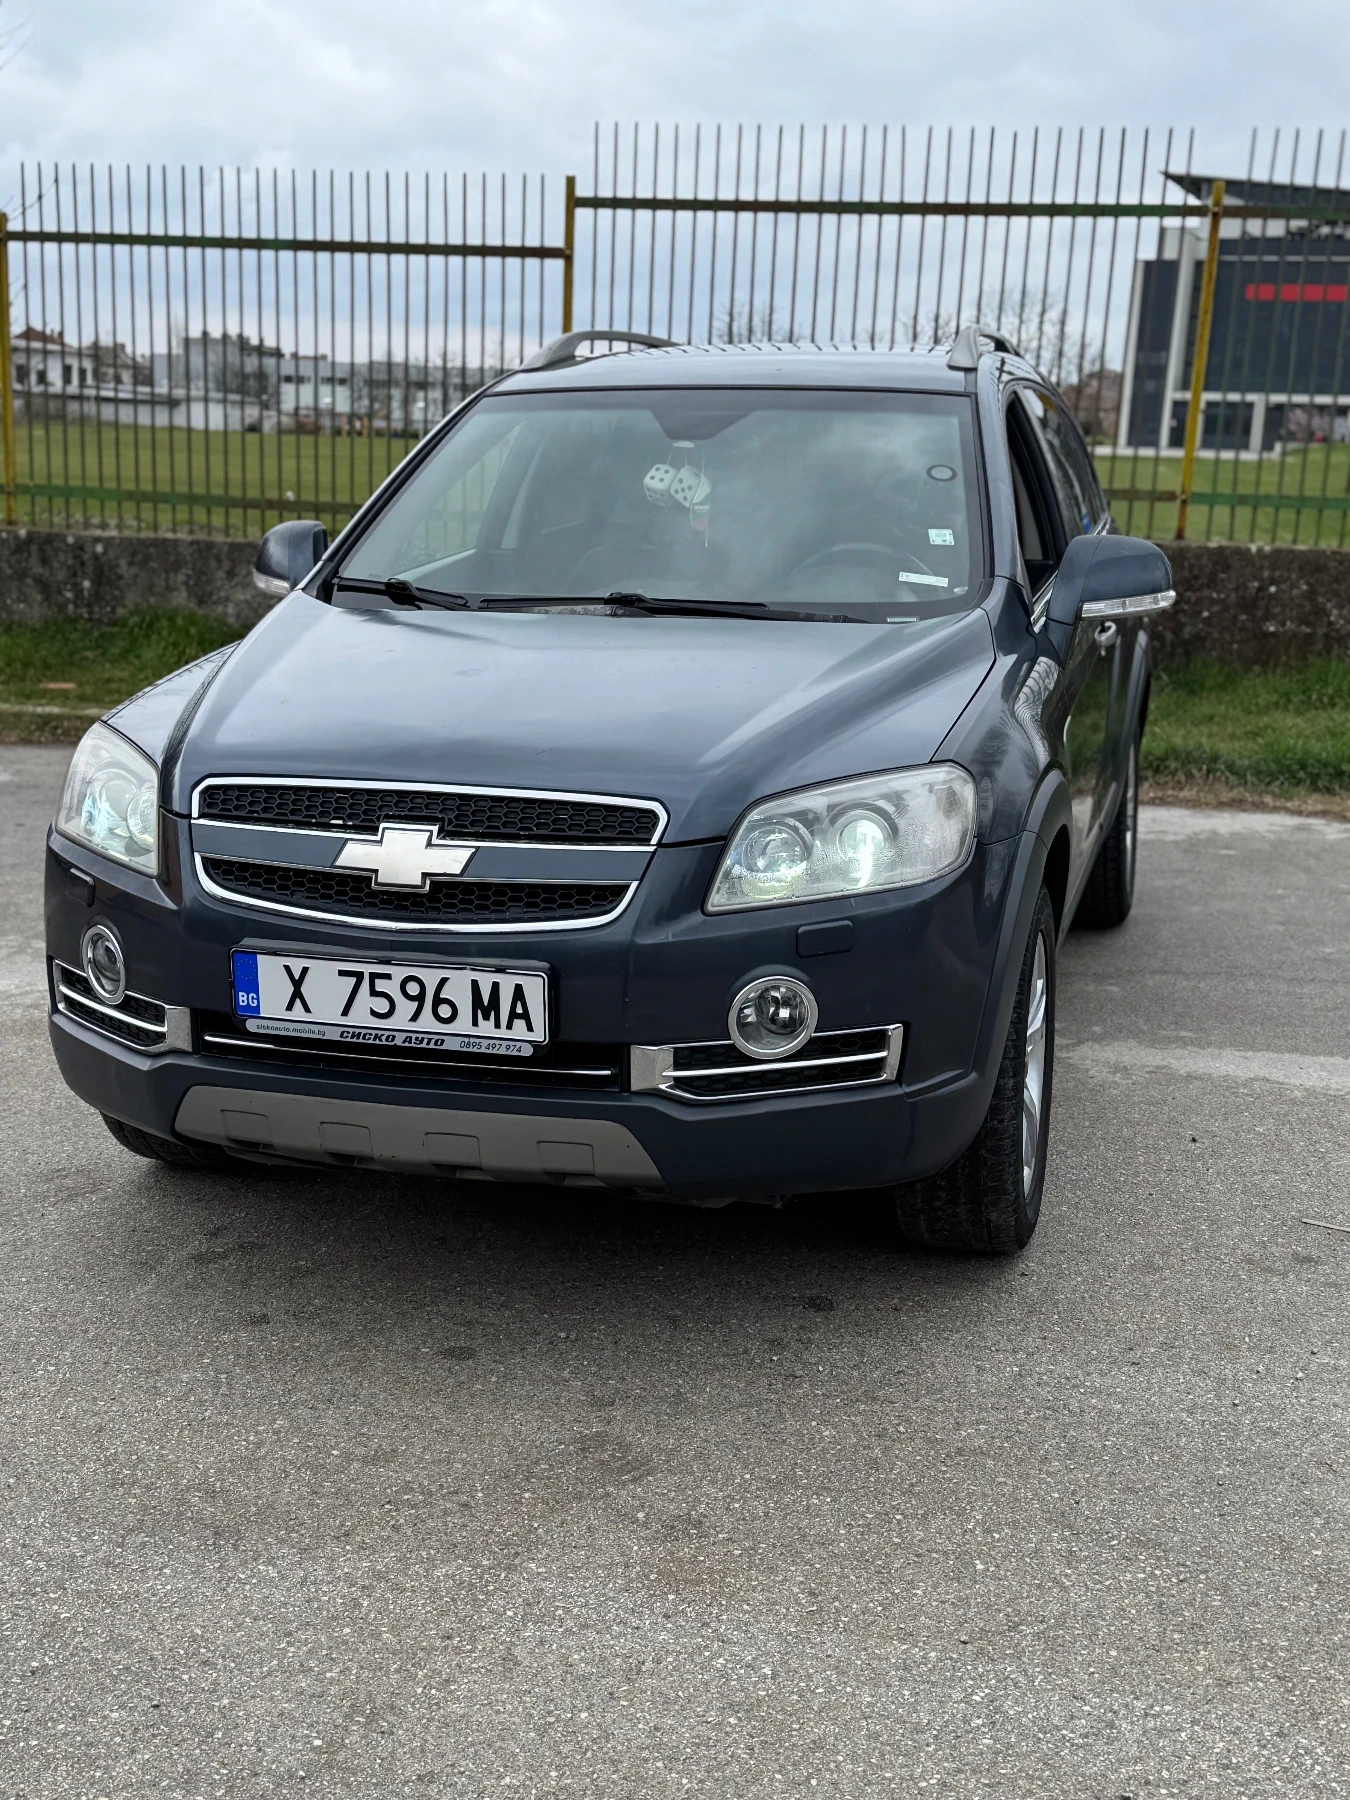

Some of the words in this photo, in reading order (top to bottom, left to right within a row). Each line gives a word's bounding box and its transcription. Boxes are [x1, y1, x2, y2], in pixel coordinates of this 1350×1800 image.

[238, 991, 258, 1007] BG
[282, 963, 313, 1014] X
[337, 969, 459, 1025] 7596
[470, 978, 535, 1033] MA
[256, 1023, 326, 1038] siskoauto.mobile.bg
[339, 1030, 397, 1044] СИСКО
[401, 1034, 446, 1048] АУТО
[459, 1039, 483, 1051] 0895
[484, 1042, 503, 1053] 497
[504, 1043, 523, 1054] 974
